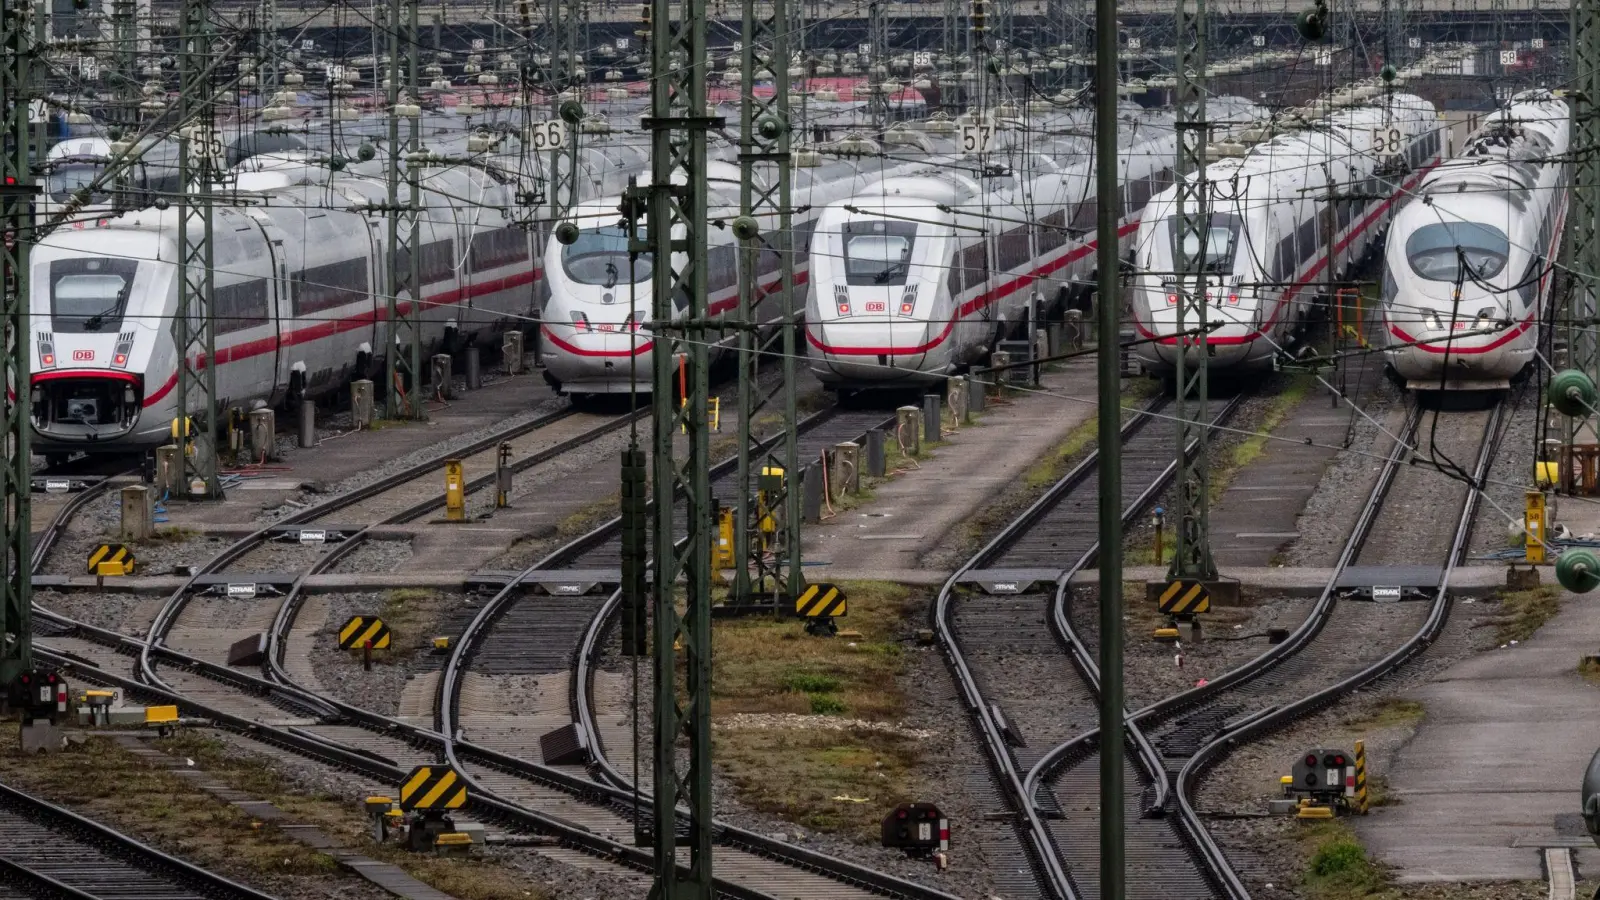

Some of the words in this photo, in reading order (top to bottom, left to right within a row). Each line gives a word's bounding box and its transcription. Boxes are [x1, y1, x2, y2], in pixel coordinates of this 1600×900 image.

[1532, 39, 1543, 47] 58
[914, 52, 929, 65] 55
[1501, 51, 1515, 63] 58
[194, 131, 221, 155] 55
[533, 122, 561, 147] 56
[964, 127, 990, 150] 57
[1374, 129, 1401, 152] 58
[76, 351, 92, 359] DB
